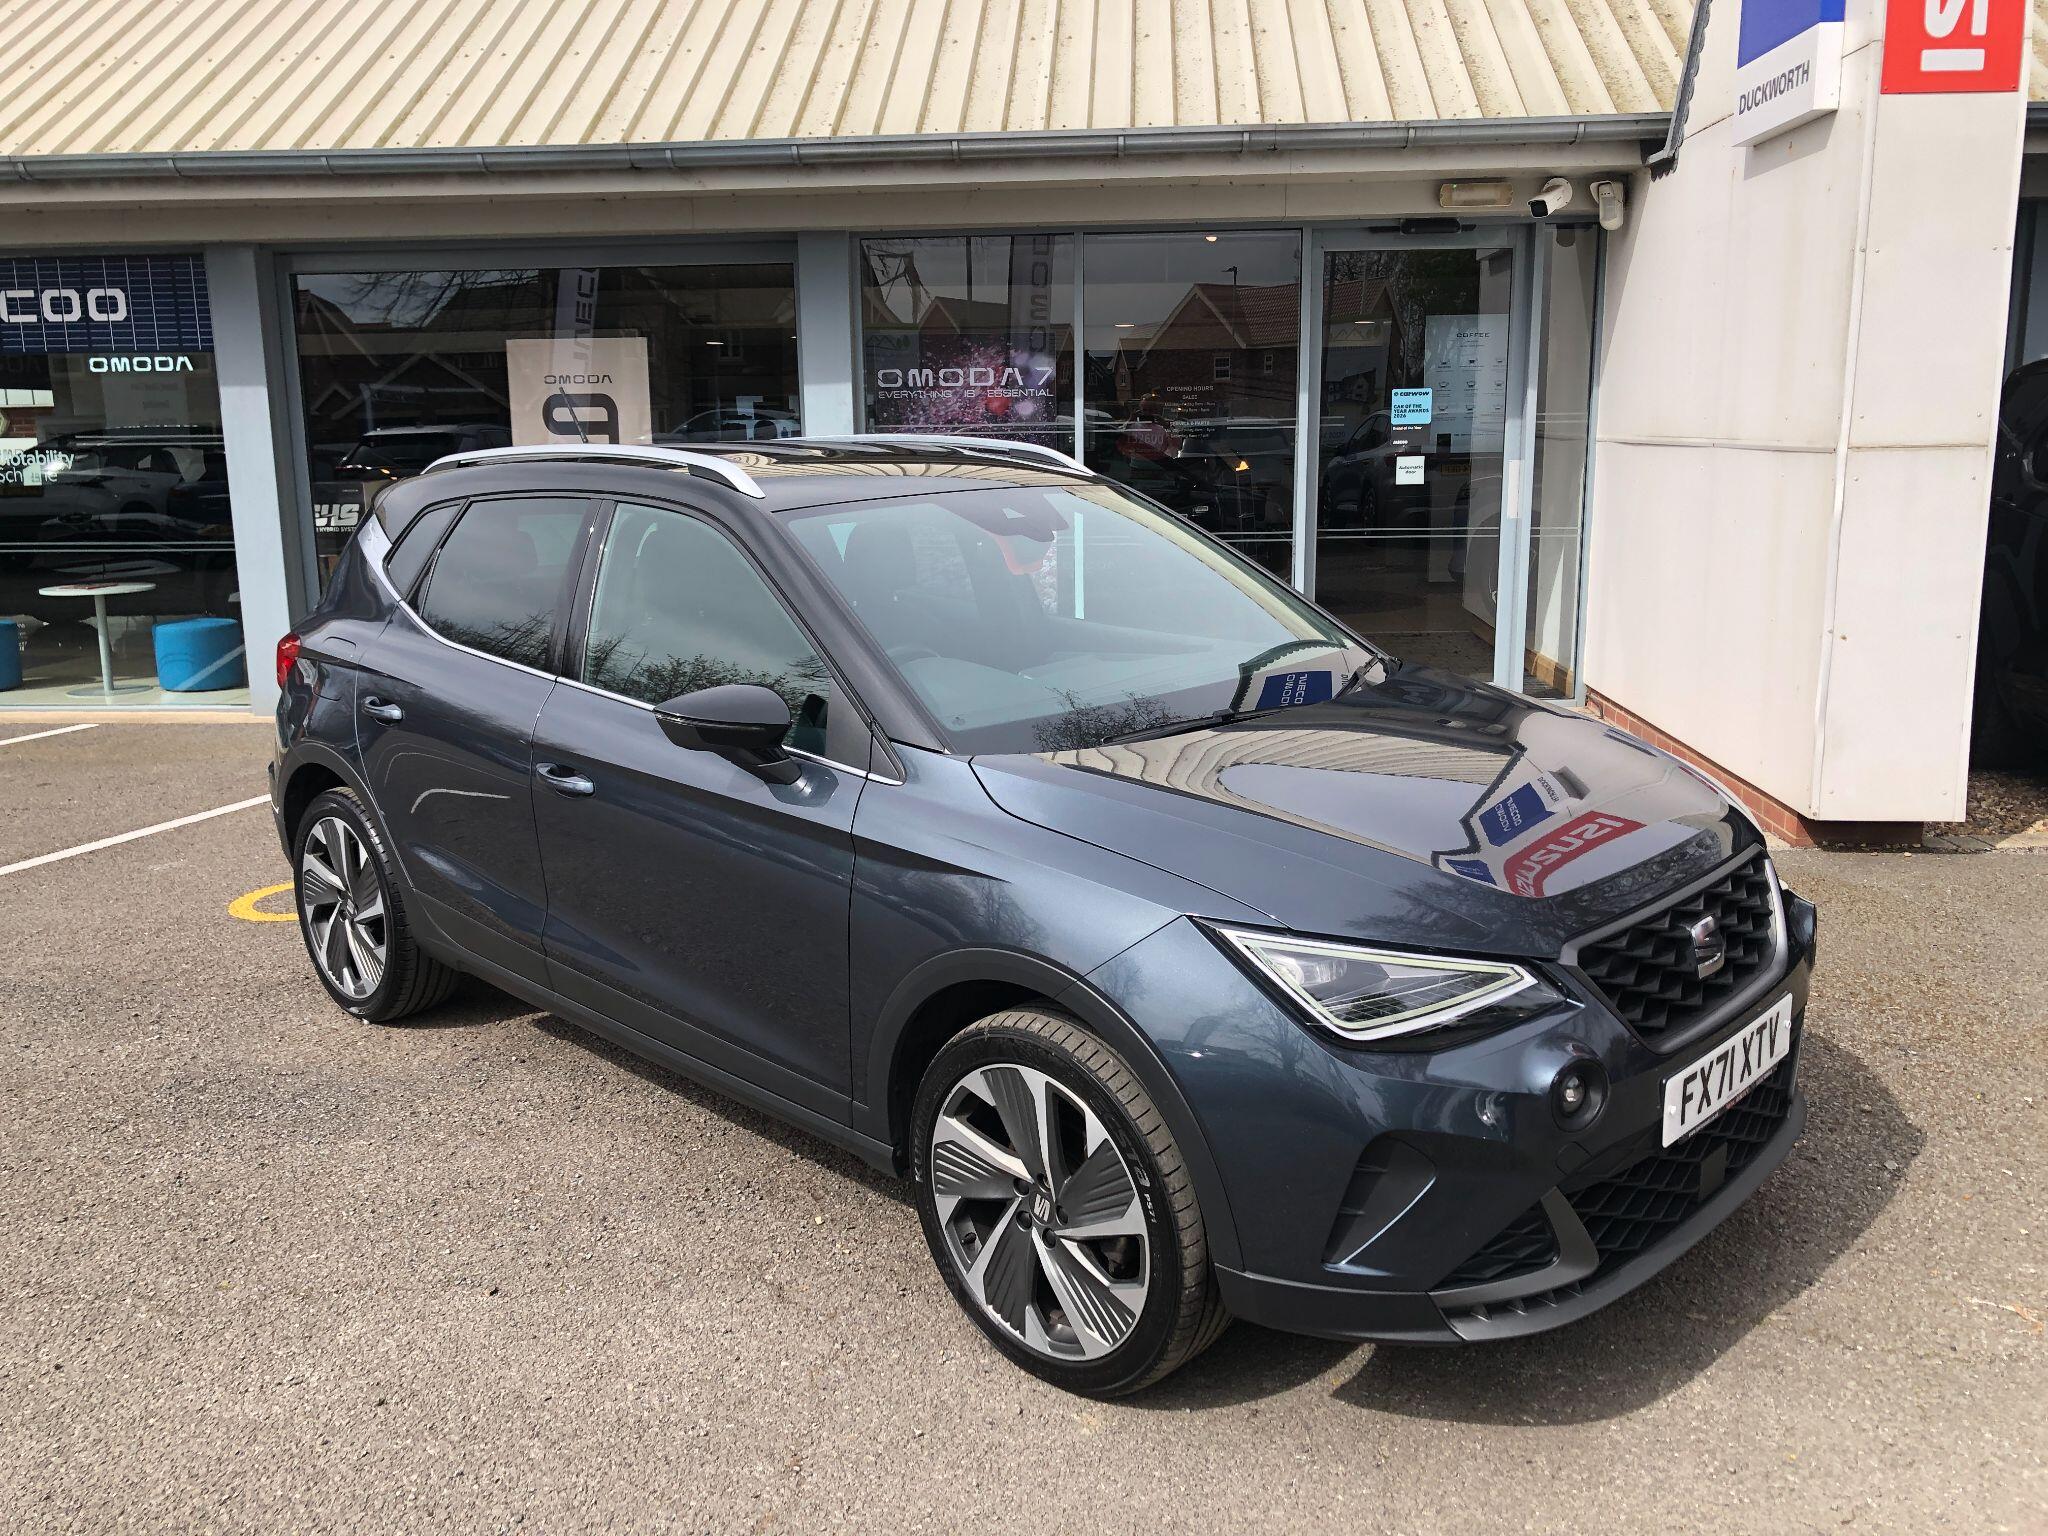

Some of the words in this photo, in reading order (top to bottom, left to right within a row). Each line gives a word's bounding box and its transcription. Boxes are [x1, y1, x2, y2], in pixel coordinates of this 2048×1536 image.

[1738, 59, 1810, 116] DUCKWORTH
[89, 356, 194, 373] OMODA
[544, 374, 613, 385] OMODA
[877, 367, 1024, 388] OMODA
[1035, 366, 1056, 387] 7
[878, 390, 952, 399] EVERYTHING
[964, 390, 976, 398] IS
[987, 388, 1054, 398] ESSENTIAL
[1680, 1045, 1735, 1126] FX71
[1739, 1012, 1781, 1083] XTV
